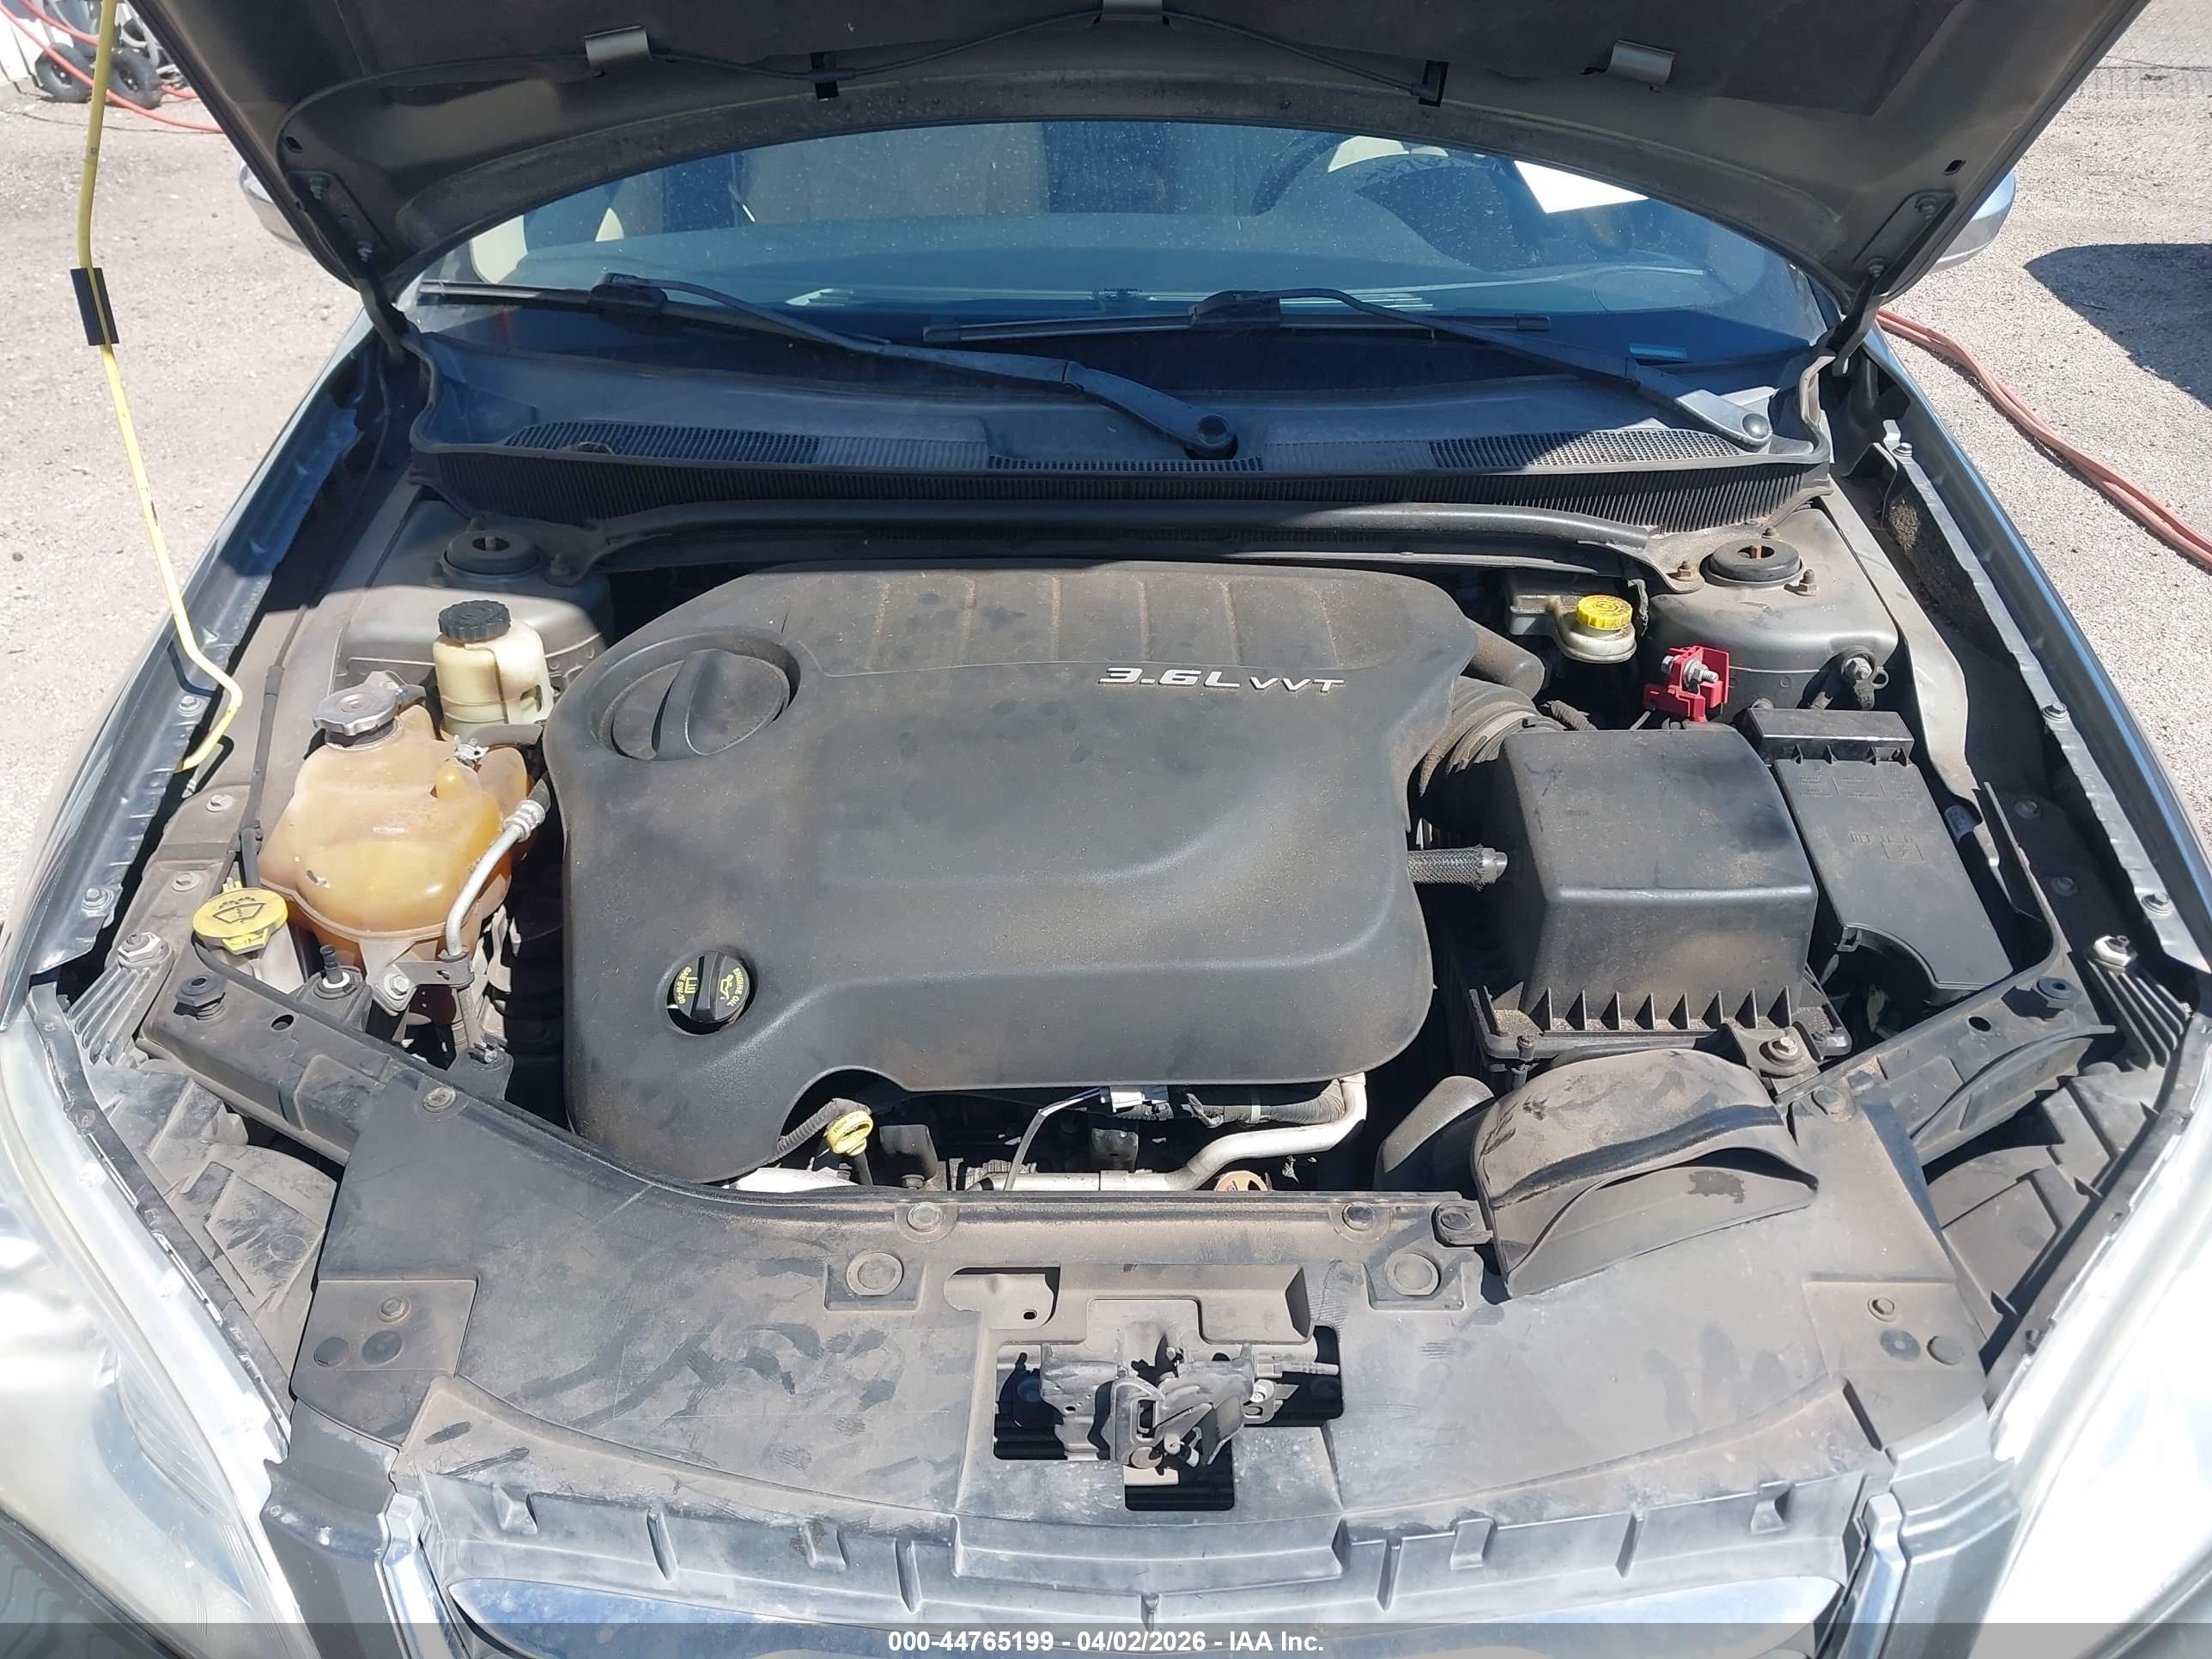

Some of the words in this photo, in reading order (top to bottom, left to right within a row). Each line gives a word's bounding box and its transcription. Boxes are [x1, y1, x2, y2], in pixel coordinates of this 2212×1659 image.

[1098, 667, 1241, 688] 3.6L
[1249, 676, 1345, 692] VVT
[678, 967, 692, 981] SAE
[732, 967, 744, 995] ENGINE
[726, 994, 739, 1007] OIL
